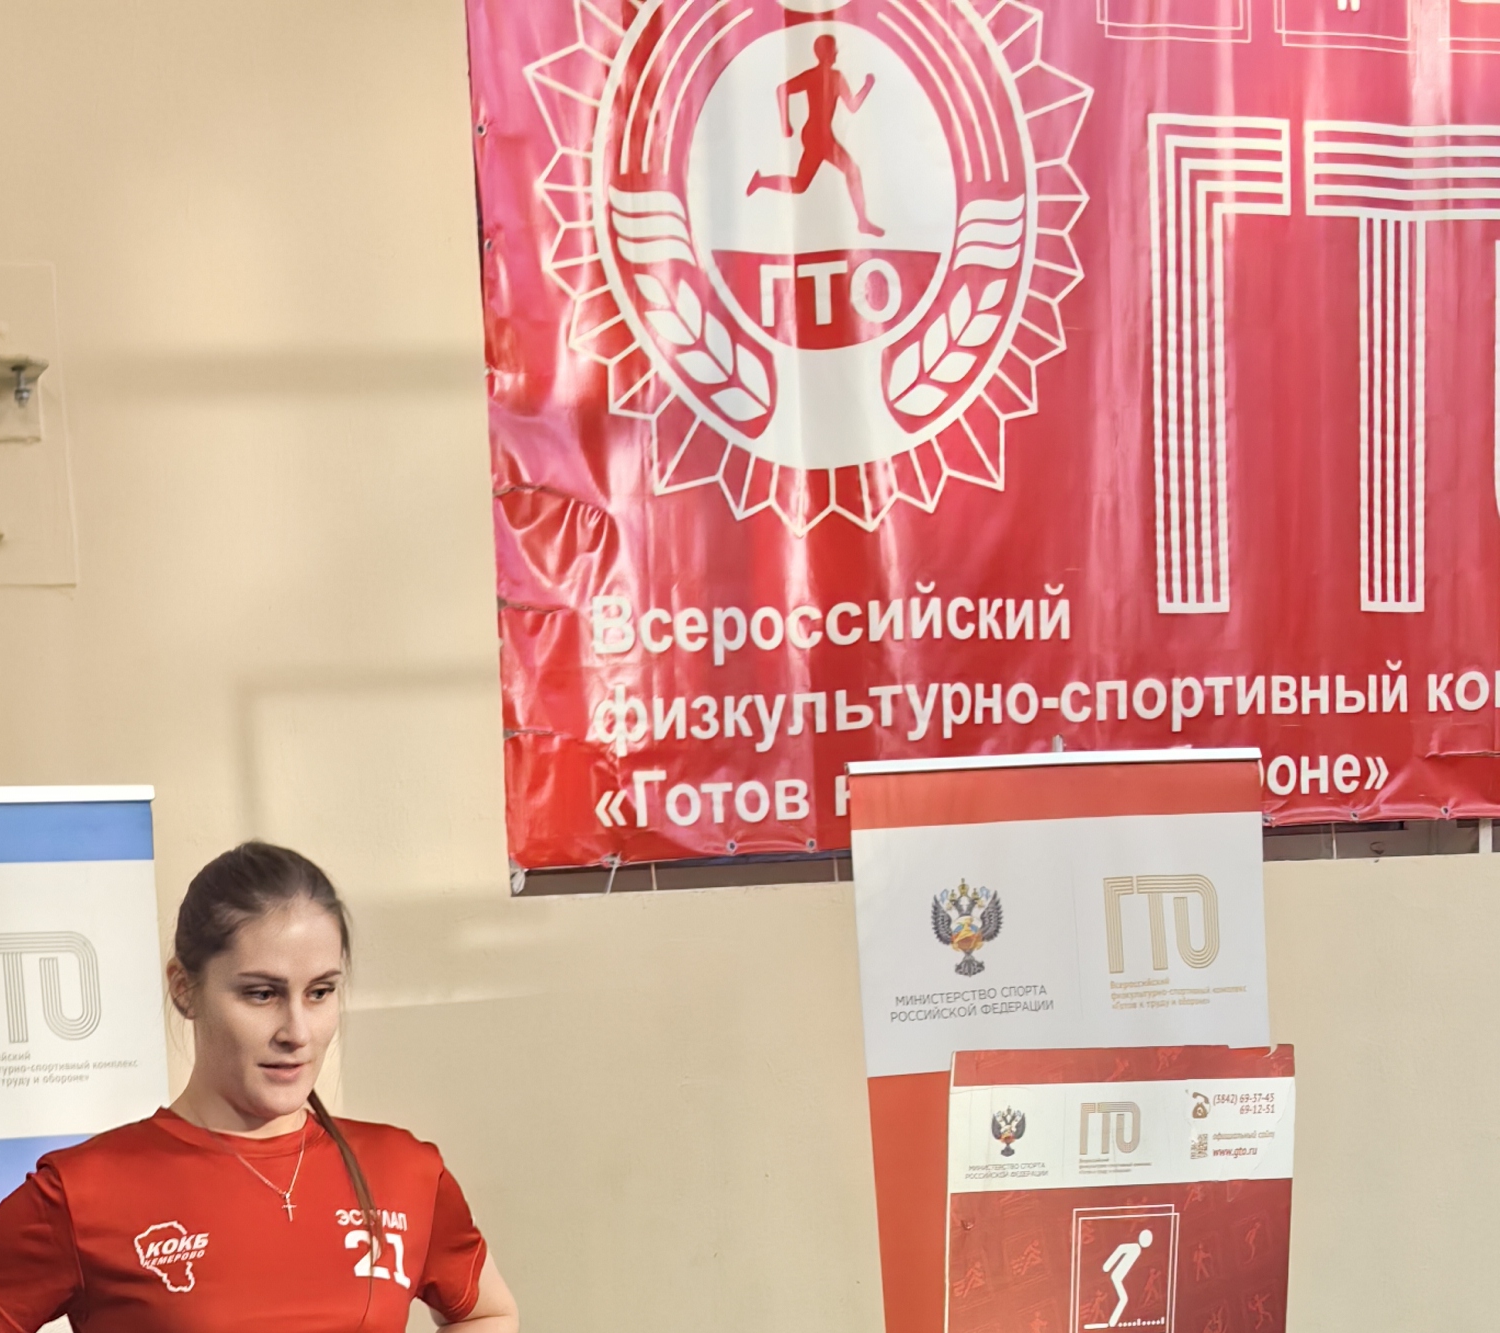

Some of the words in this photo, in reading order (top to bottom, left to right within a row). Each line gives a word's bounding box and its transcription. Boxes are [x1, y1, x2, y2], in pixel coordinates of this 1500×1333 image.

[759, 258, 902, 327] ГТО
[1148, 112, 1500, 613] ГТ
[591, 580, 1071, 666] Всероссийский
[593, 660, 1408, 757] физкультурно-спортивный
[1428, 669, 1500, 713] ко
[595, 769, 810, 828] «Готов
[1262, 753, 1389, 796] оне»
[1103, 873, 1220, 974] ГТО
[890, 1004, 978, 1023] РОССИЙСКОЙ
[980, 999, 1055, 1015] ФЕДЕРАЦИИ
[895, 987, 998, 1006] МИНИСТЕРСТВО
[1000, 985, 1048, 998] СПОРТА
[1079, 1101, 1142, 1156] ГТО
[145, 1233, 210, 1259] КОКБ
[335, 1208, 408, 1232] ЭСЛАП
[344, 1229, 411, 1290] 21
